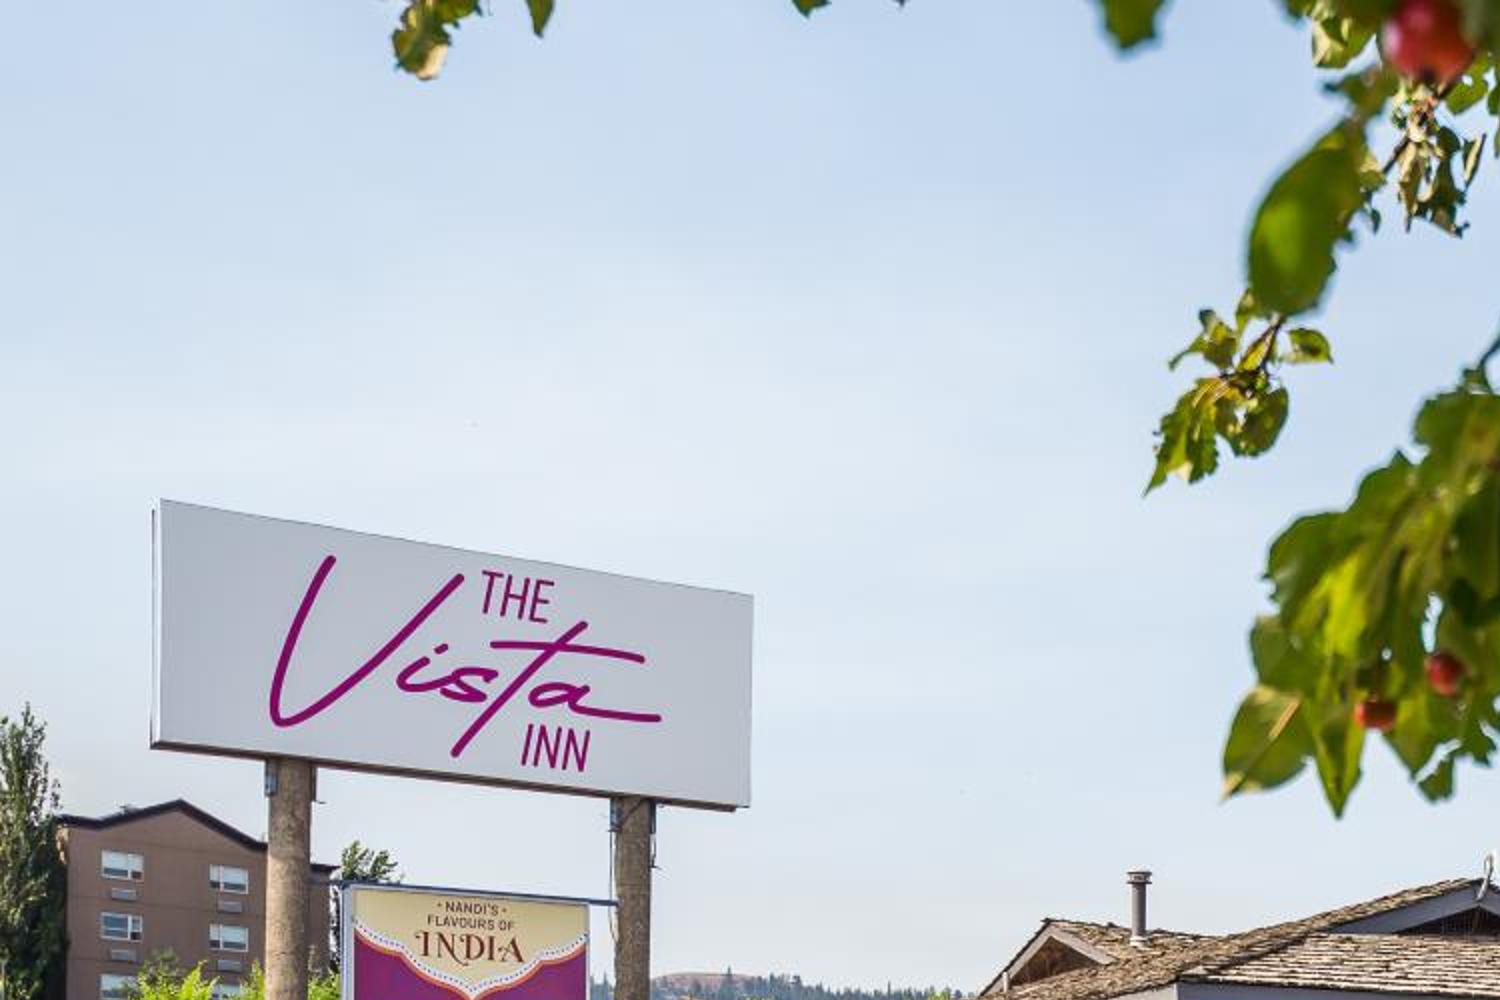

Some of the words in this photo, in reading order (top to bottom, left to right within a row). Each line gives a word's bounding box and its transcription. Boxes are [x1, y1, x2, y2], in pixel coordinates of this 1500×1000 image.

[481, 570, 555, 624] THE
[269, 555, 662, 758] Vista
[520, 723, 591, 772] INN
[427, 914, 495, 931] FLAVOURS
[498, 919, 515, 932] OF
[445, 901, 499, 917] NANDI'S
[415, 931, 525, 967] INDIA
